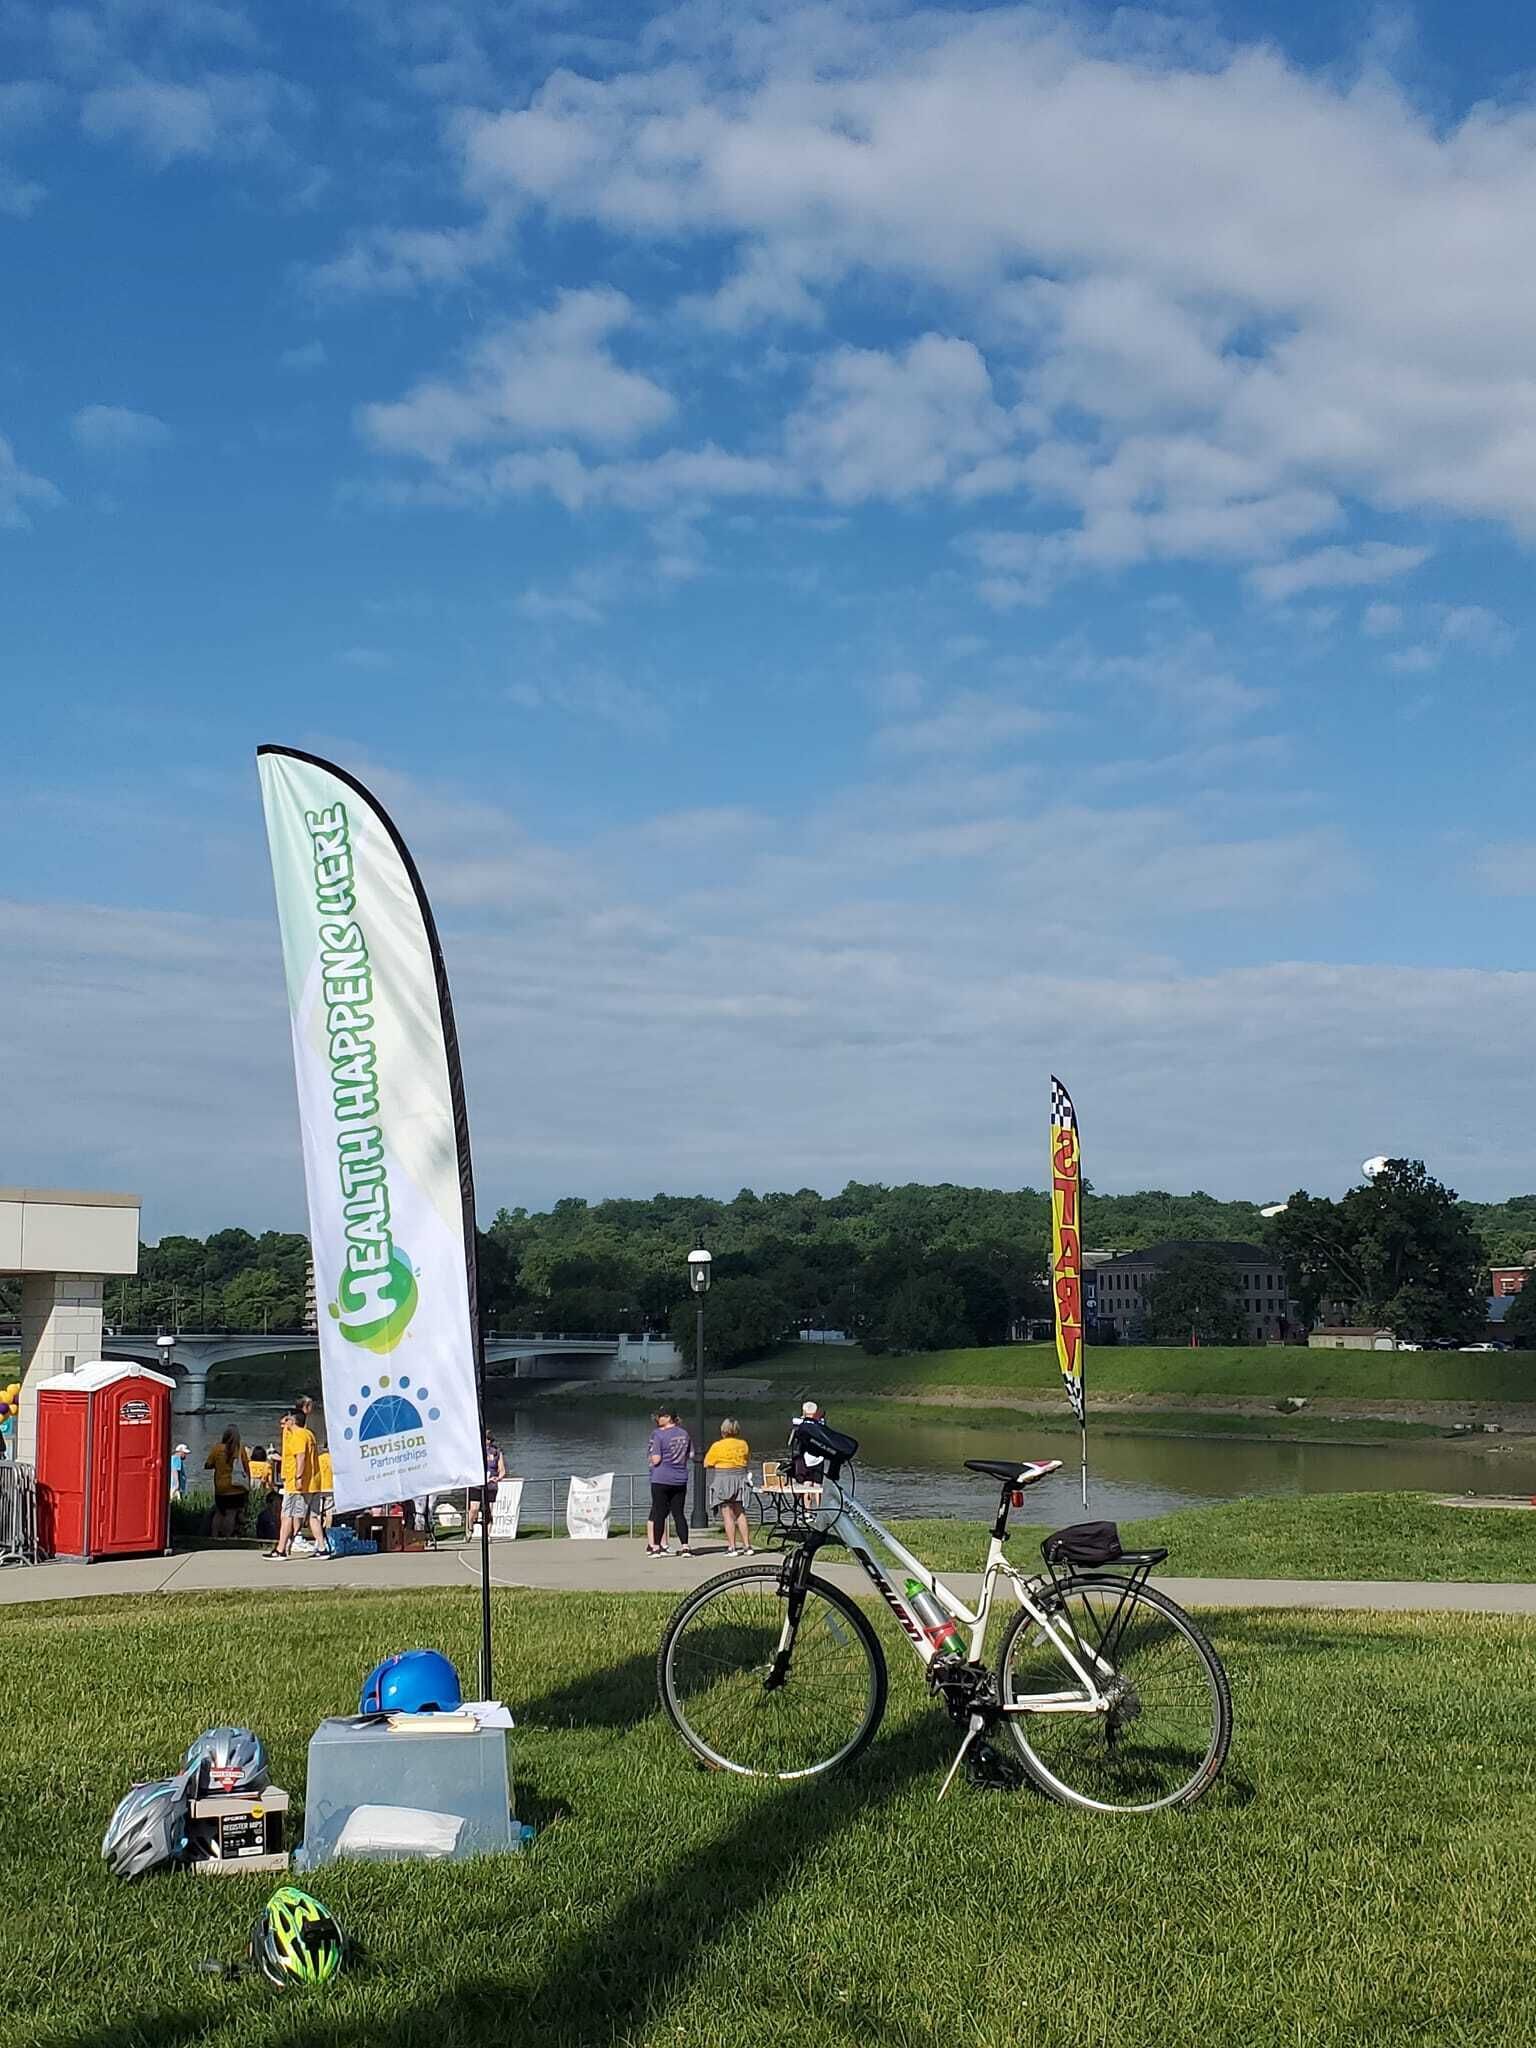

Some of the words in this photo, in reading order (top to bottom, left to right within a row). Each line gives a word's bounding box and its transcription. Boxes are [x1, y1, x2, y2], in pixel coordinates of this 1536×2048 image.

[305, 801, 357, 920] HERE
[319, 921, 379, 1124] HAPPENS
[336, 1125, 397, 1328] HEALTH
[360, 1435, 426, 1459] Envision
[370, 1449, 428, 1469] Partnerships
